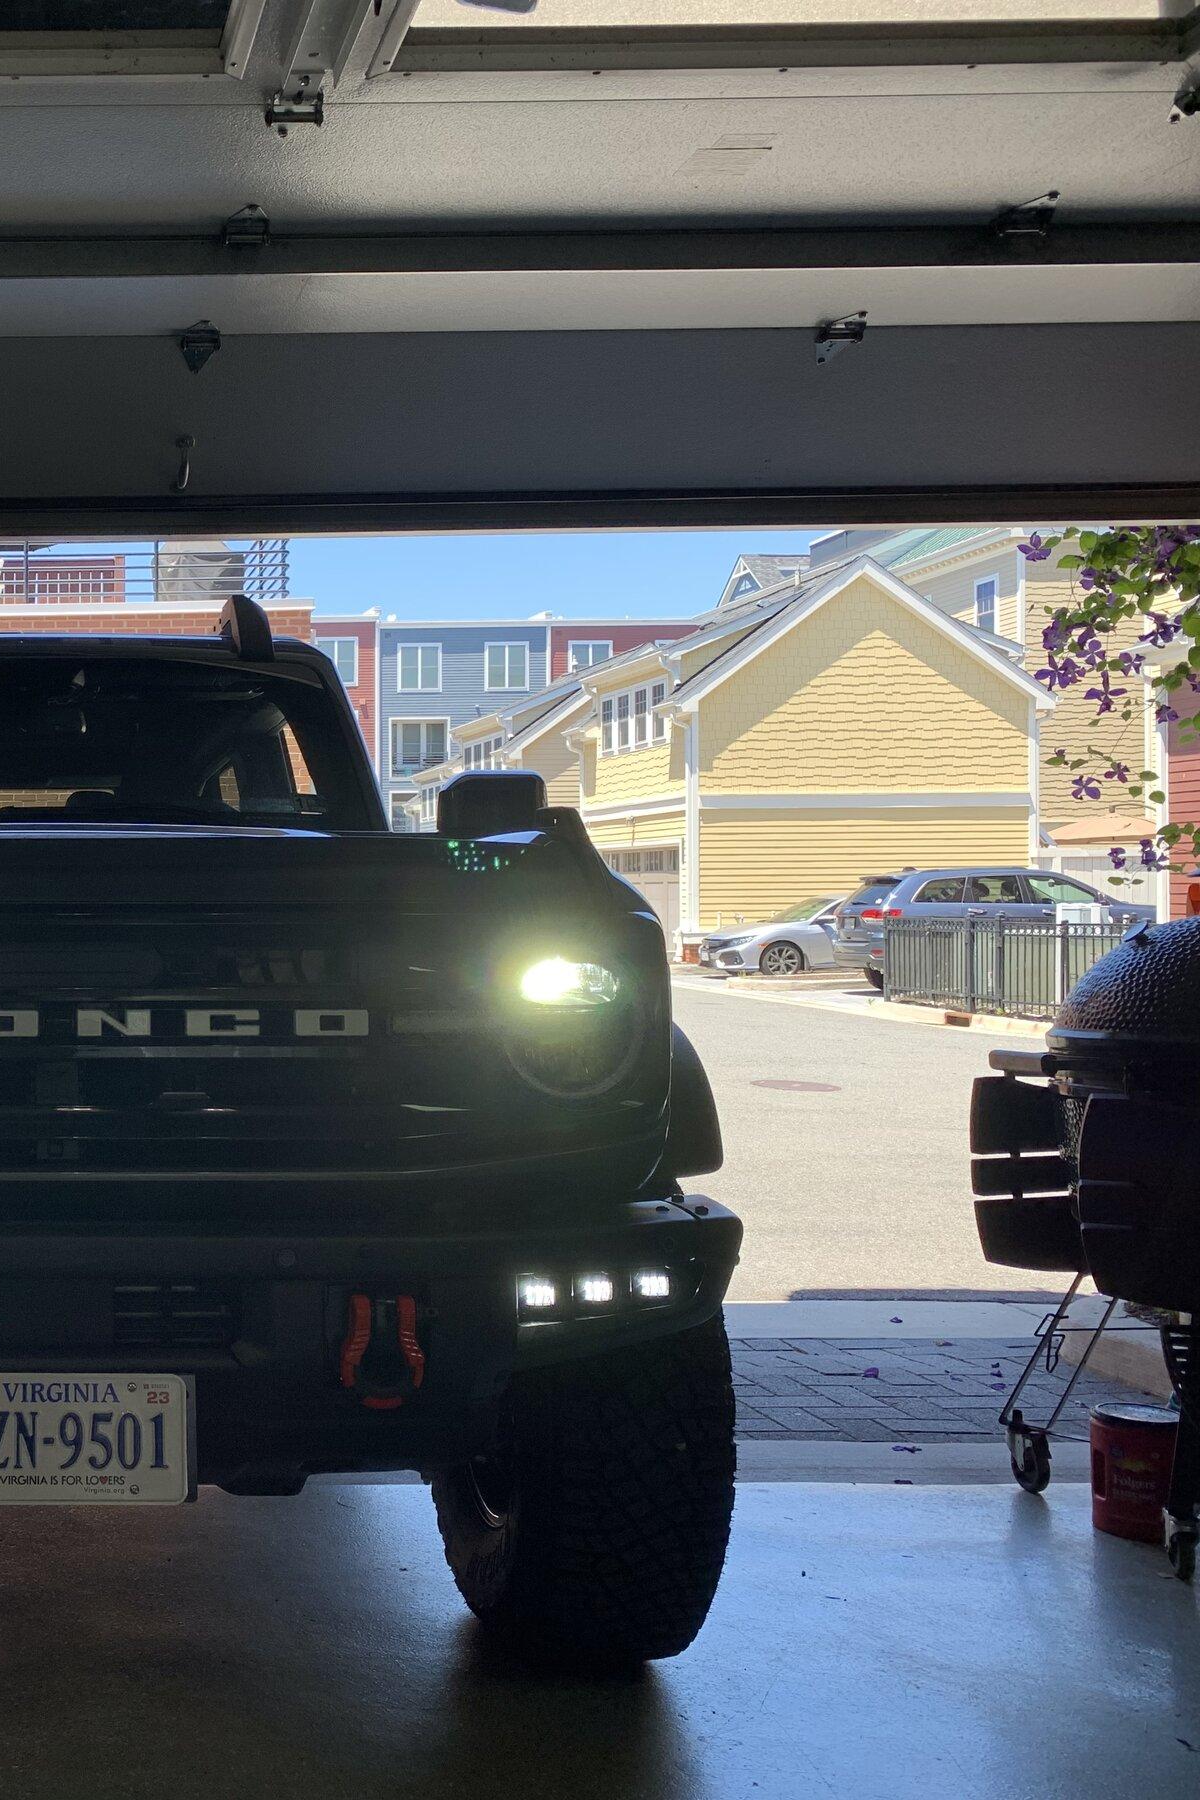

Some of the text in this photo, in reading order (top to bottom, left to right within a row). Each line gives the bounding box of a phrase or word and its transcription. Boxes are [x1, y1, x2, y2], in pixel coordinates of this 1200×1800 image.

[2, 1383, 120, 1403] VIRGINIA
[147, 1391, 170, 1404] 23
[0, 1475, 48, 1485] VIRGINIA
[50, 1475, 58, 1485] IS
[61, 1475, 83, 1485] FOR
